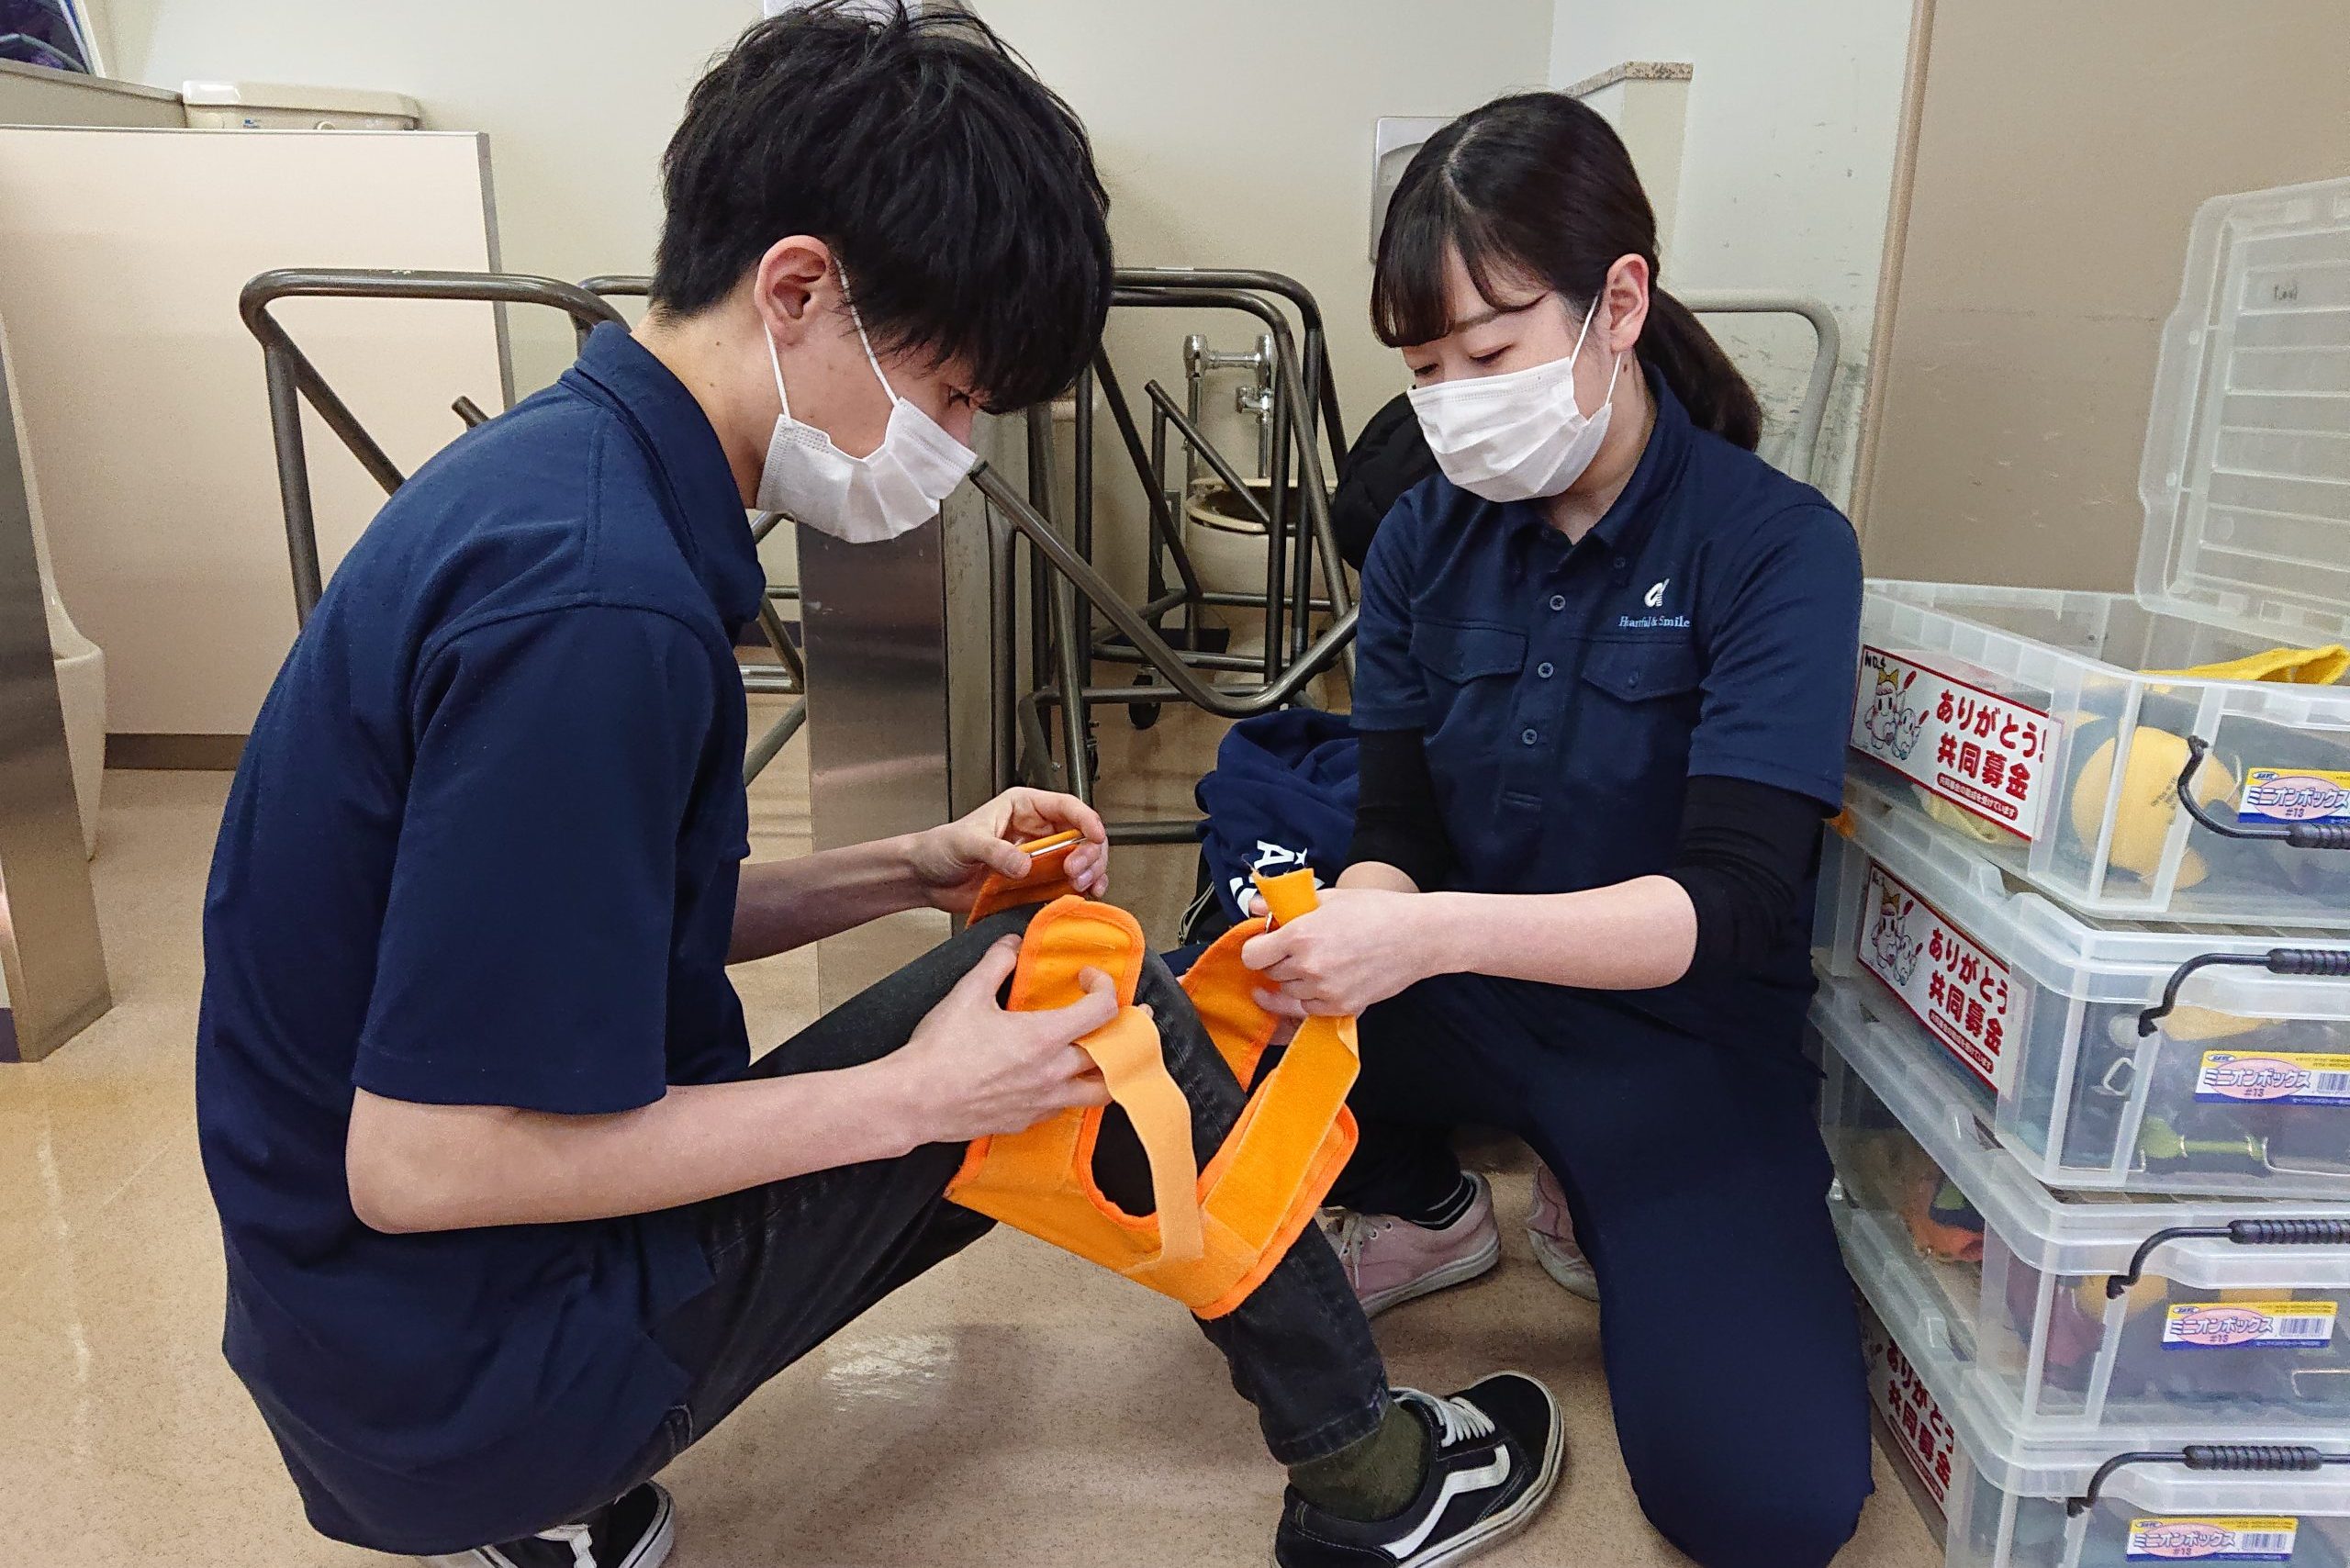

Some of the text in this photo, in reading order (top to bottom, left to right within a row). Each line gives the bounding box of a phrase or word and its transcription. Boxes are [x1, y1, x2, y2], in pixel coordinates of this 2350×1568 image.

[1937, 732, 2031, 801] 共同募金
[2247, 786, 2350, 809] ミニオンボックス
[2284, 808, 2305, 818] #13
[1929, 969, 2004, 1057] 共同募金
[2203, 1068, 2311, 1089] ミニオンボックス
[2244, 1088, 2265, 1098] #13
[2169, 1316, 2275, 1335] ミニオンボックス
[2133, 1531, 2236, 1548] ミニオンボックス
